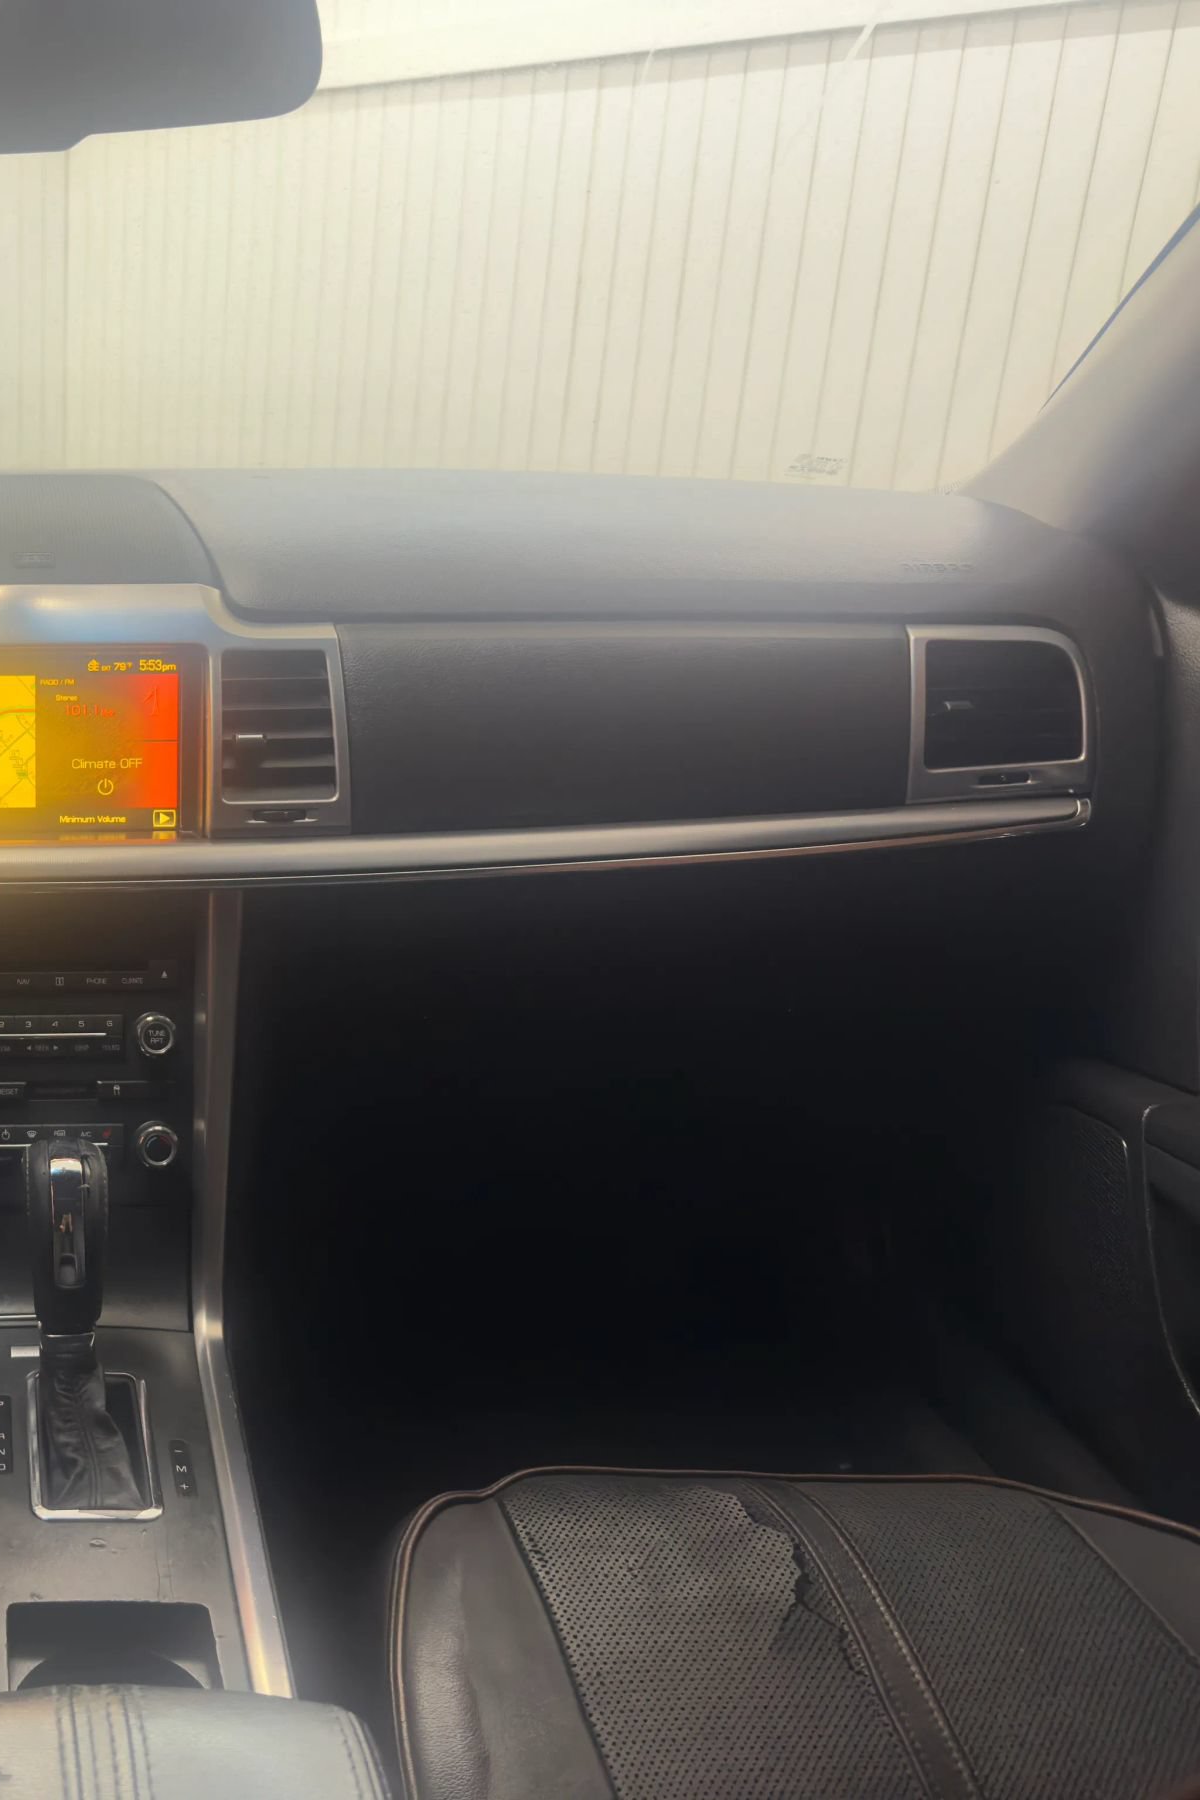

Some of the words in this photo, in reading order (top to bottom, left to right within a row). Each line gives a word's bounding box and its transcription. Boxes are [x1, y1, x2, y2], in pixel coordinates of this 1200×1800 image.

[55, 694, 79, 702] Stereo
[65, 704, 100, 717] 101.1
[72, 758, 116, 769] Climate
[120, 758, 142, 769] OFF
[59, 815, 95, 824] Minimum
[97, 815, 126, 824] Volume
[16, 977, 30, 986] NAV
[148, 1029, 165, 1037] TUNE
[176, 1465, 187, 1473] M
